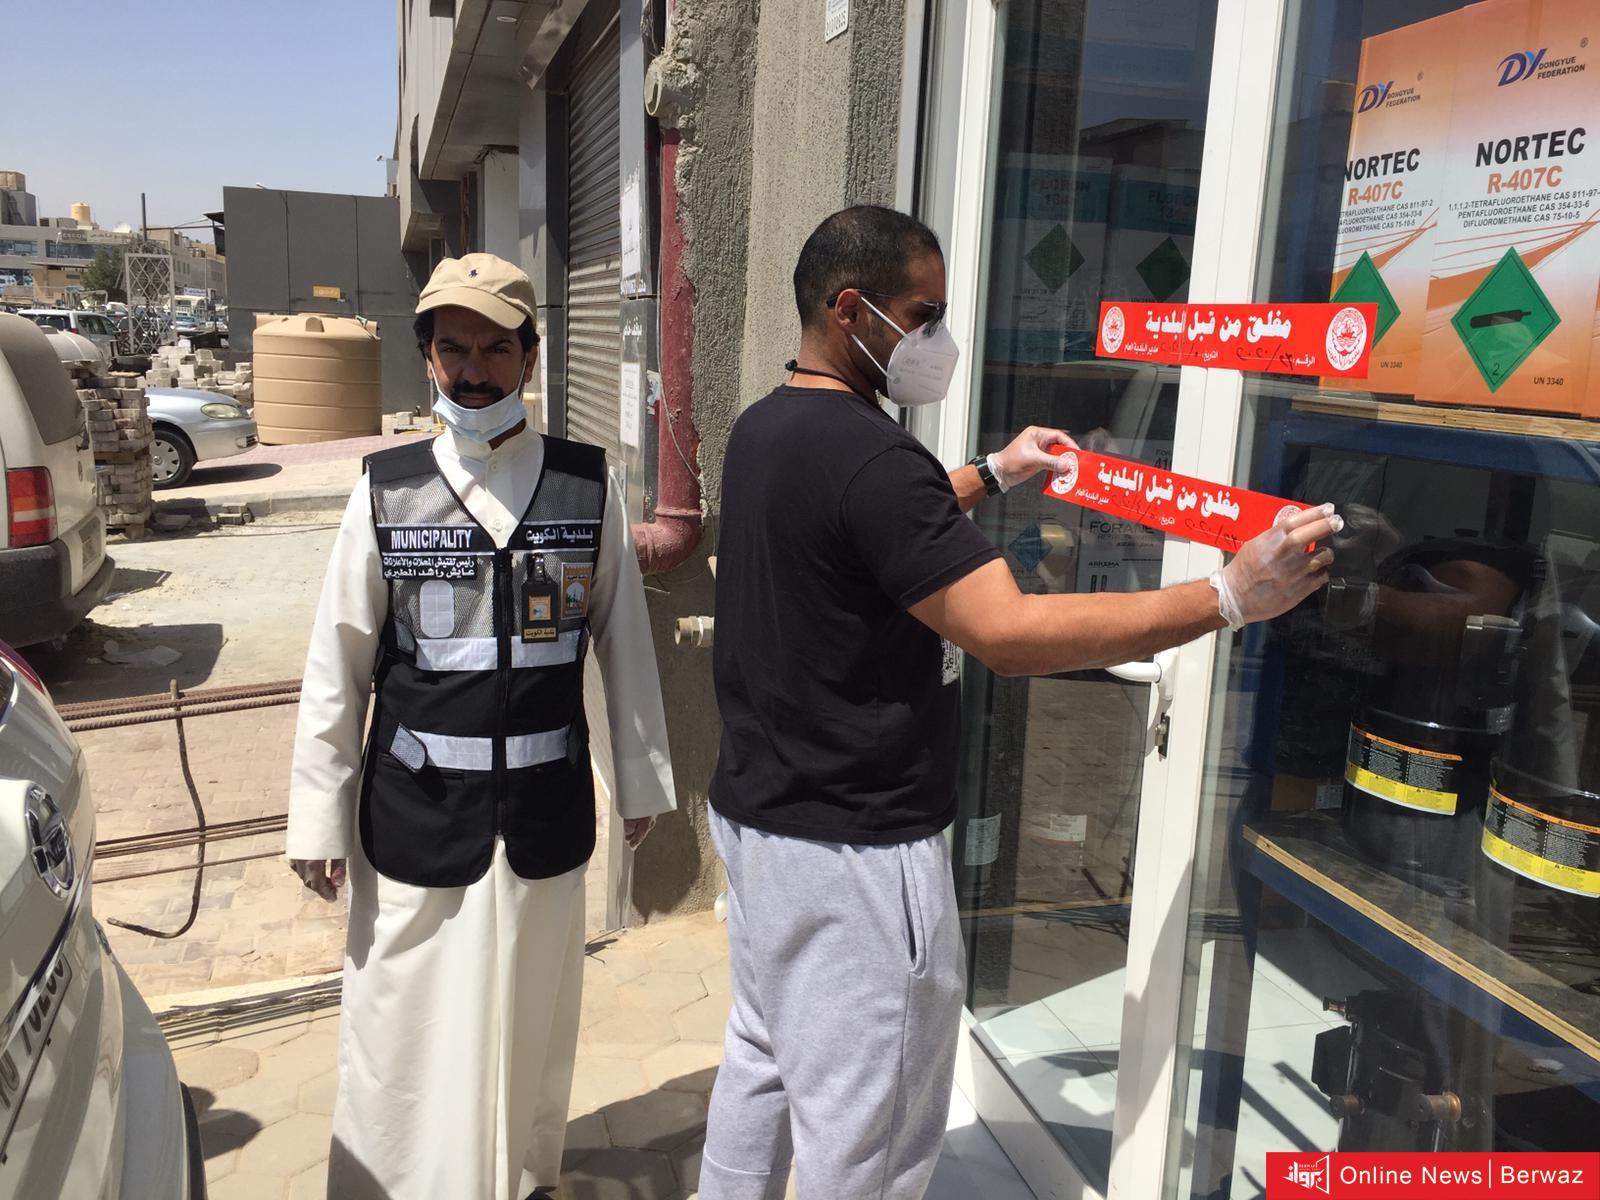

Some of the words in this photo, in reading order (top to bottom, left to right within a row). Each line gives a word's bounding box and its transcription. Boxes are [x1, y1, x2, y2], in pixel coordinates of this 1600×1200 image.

[1537, 64, 1585, 79] FEDERATION
[1538, 56, 1576, 70] DONGYUE
[1475, 127, 1586, 167] NORTEC
[1487, 165, 1563, 194] R-407C
[1348, 180, 1404, 206] R-407C
[1553, 191, 1570, 201] CAS
[1572, 188, 1600, 199] 811-97-
[1386, 212, 1398, 220] CAS
[1458, 203, 1537, 219] PENTAFLUOROETHANE
[1539, 202, 1555, 212] CAS
[1557, 200, 1590, 211] 354-33-6
[1382, 222, 1394, 230] CAS
[1463, 215, 1532, 228] DIFLUOROMETHANE
[1534, 213, 1550, 222] CAS
[1553, 211, 1580, 220] 75-10-5
[1187, 310, 1216, 342] قبل
[1219, 316, 1242, 342] من
[1380, 361, 1390, 369] UN
[1534, 377, 1545, 385] UN
[1546, 377, 1564, 386] 3340
[1097, 462, 1144, 496] البلدية
[1145, 475, 1174, 505] قبل
[1176, 487, 1197, 511] من
[391, 529, 473, 550] MUNICIPALITY
[526, 527, 560, 544] الكويت
[562, 526, 594, 544] بلدية
[434, 557, 456, 568] تفتيش
[384, 569, 417, 578] المطيري
[418, 568, 445, 578] راشد
